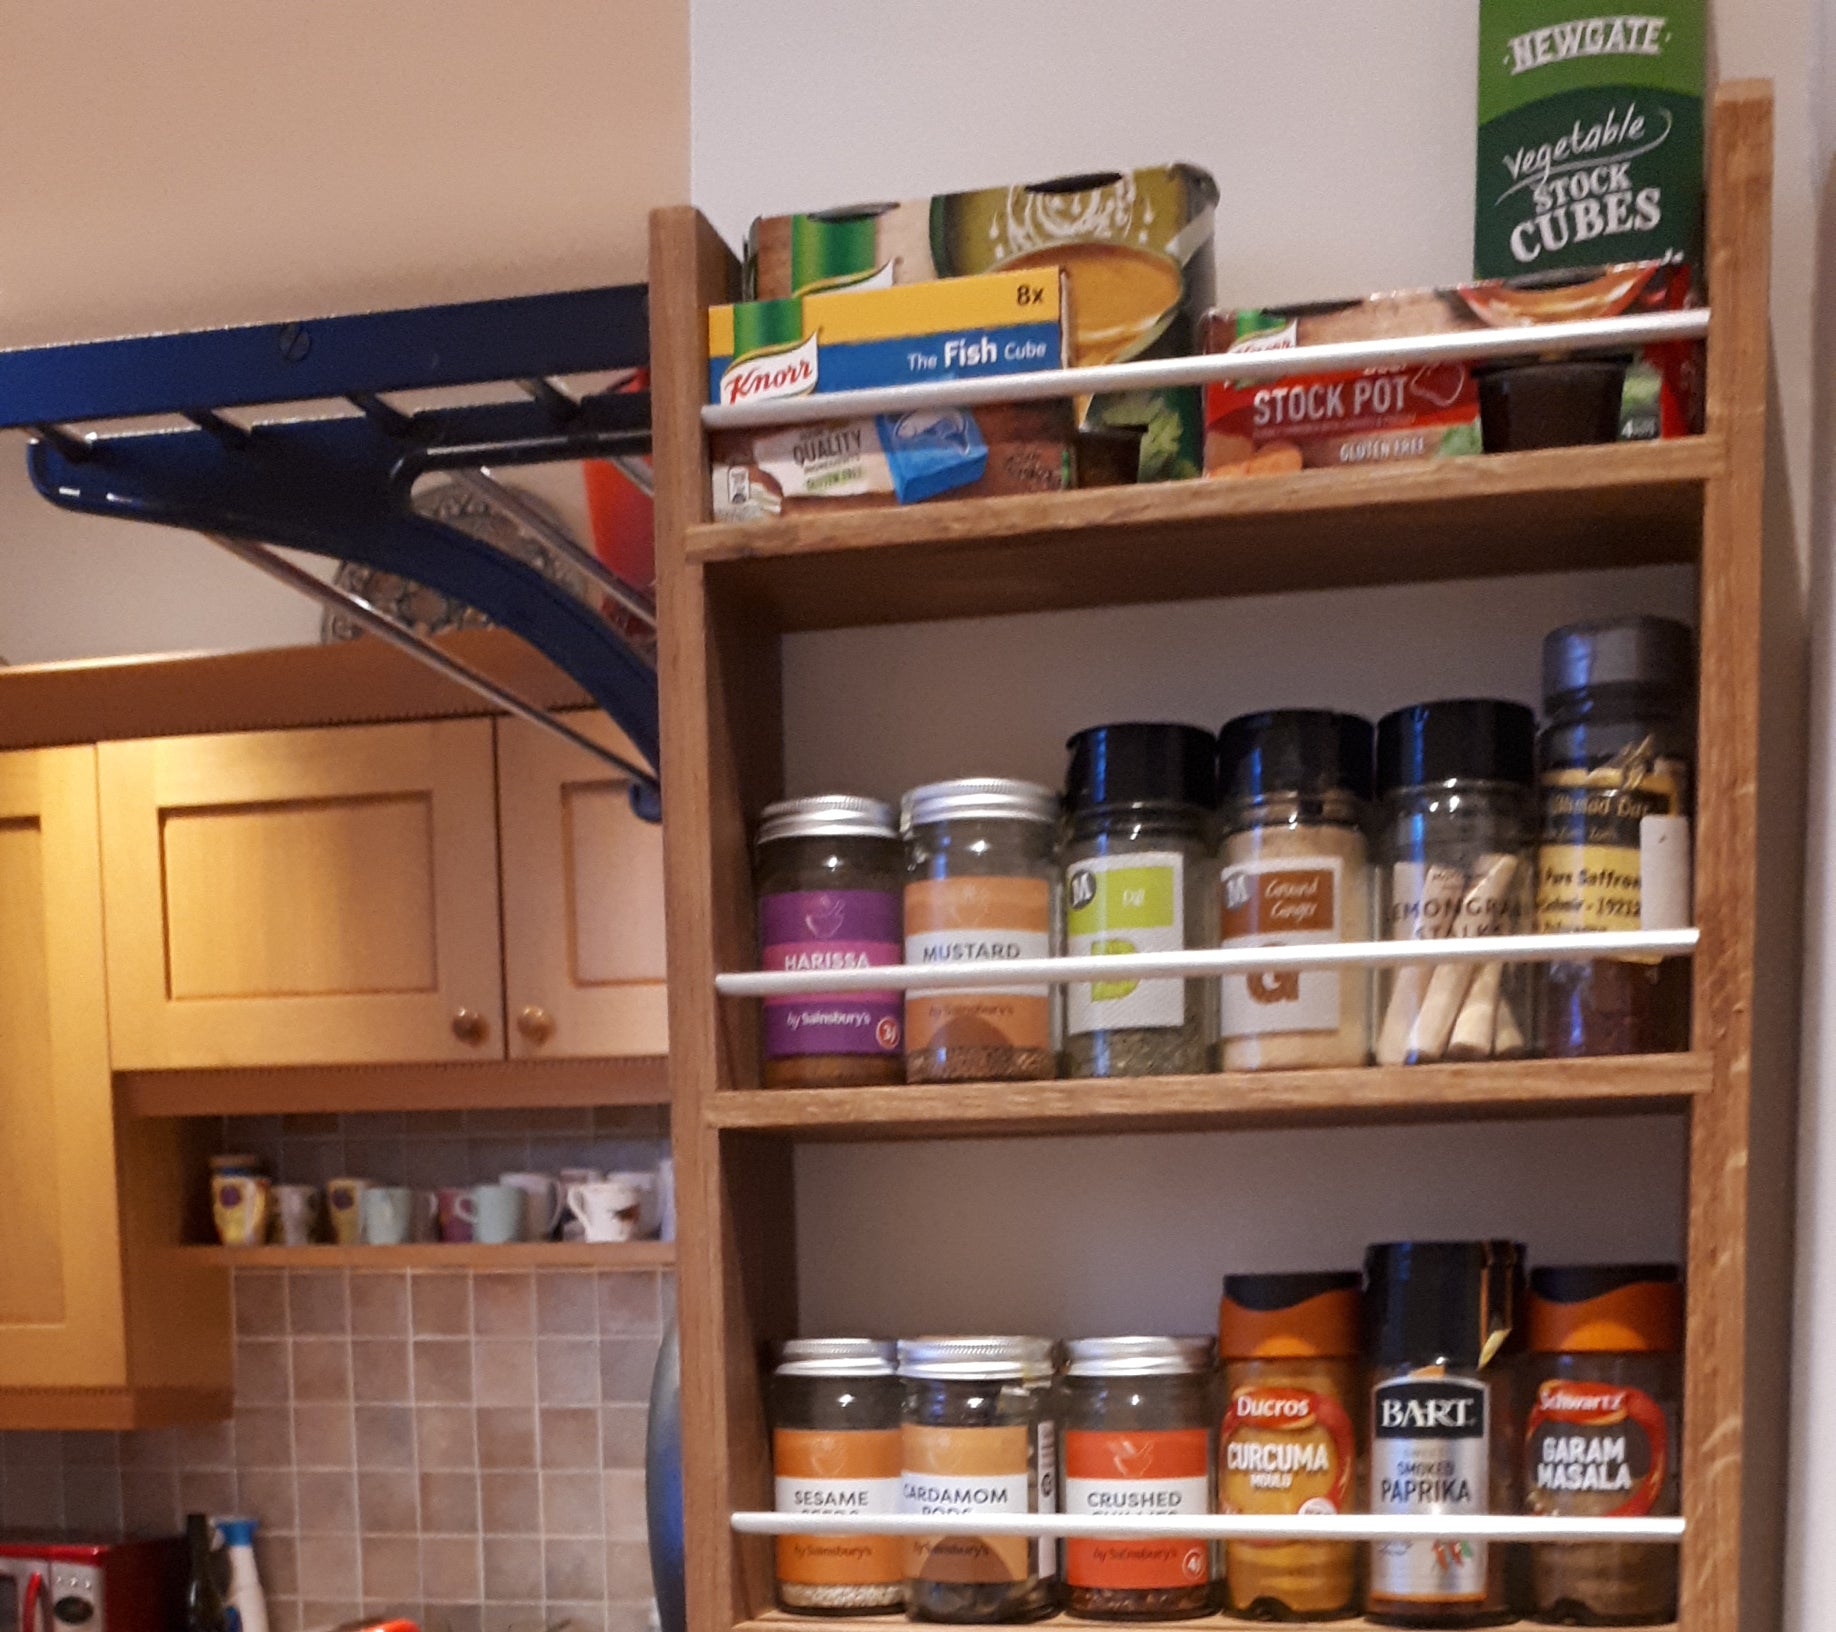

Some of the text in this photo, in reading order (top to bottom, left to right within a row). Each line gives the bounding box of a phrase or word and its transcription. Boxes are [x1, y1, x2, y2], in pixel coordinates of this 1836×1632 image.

[1509, 17, 1666, 75] NEWGATE
[1533, 162, 1633, 213] STOCK
[1510, 188, 1661, 262] CUBES
[1017, 284, 1045, 306] 8x
[907, 337, 1046, 371] The Fish Cube
[724, 358, 814, 404] Knorr
[1253, 375, 1408, 426] STOCK POT
[793, 430, 861, 468] QUALITY
[1340, 440, 1390, 464] GLUTEN
[784, 951, 871, 972] HARISSA
[922, 941, 1021, 963] MUSTARD
[1236, 1395, 1310, 1418] Ducros
[1380, 1398, 1475, 1428] BART
[1539, 1390, 1626, 1412] Schwartz
[1227, 1441, 1330, 1473] CURCUMA
[1542, 1435, 1627, 1464] GARAM
[1396, 1459, 1456, 1476] SMOKED
[1537, 1462, 1632, 1492] MASALA
[794, 1490, 869, 1507] SESAME
[903, 1482, 1009, 1506] CARDAMOM
[1087, 1490, 1183, 1509] CRUSHED
[1380, 1478, 1472, 1504] PAPRIKA
